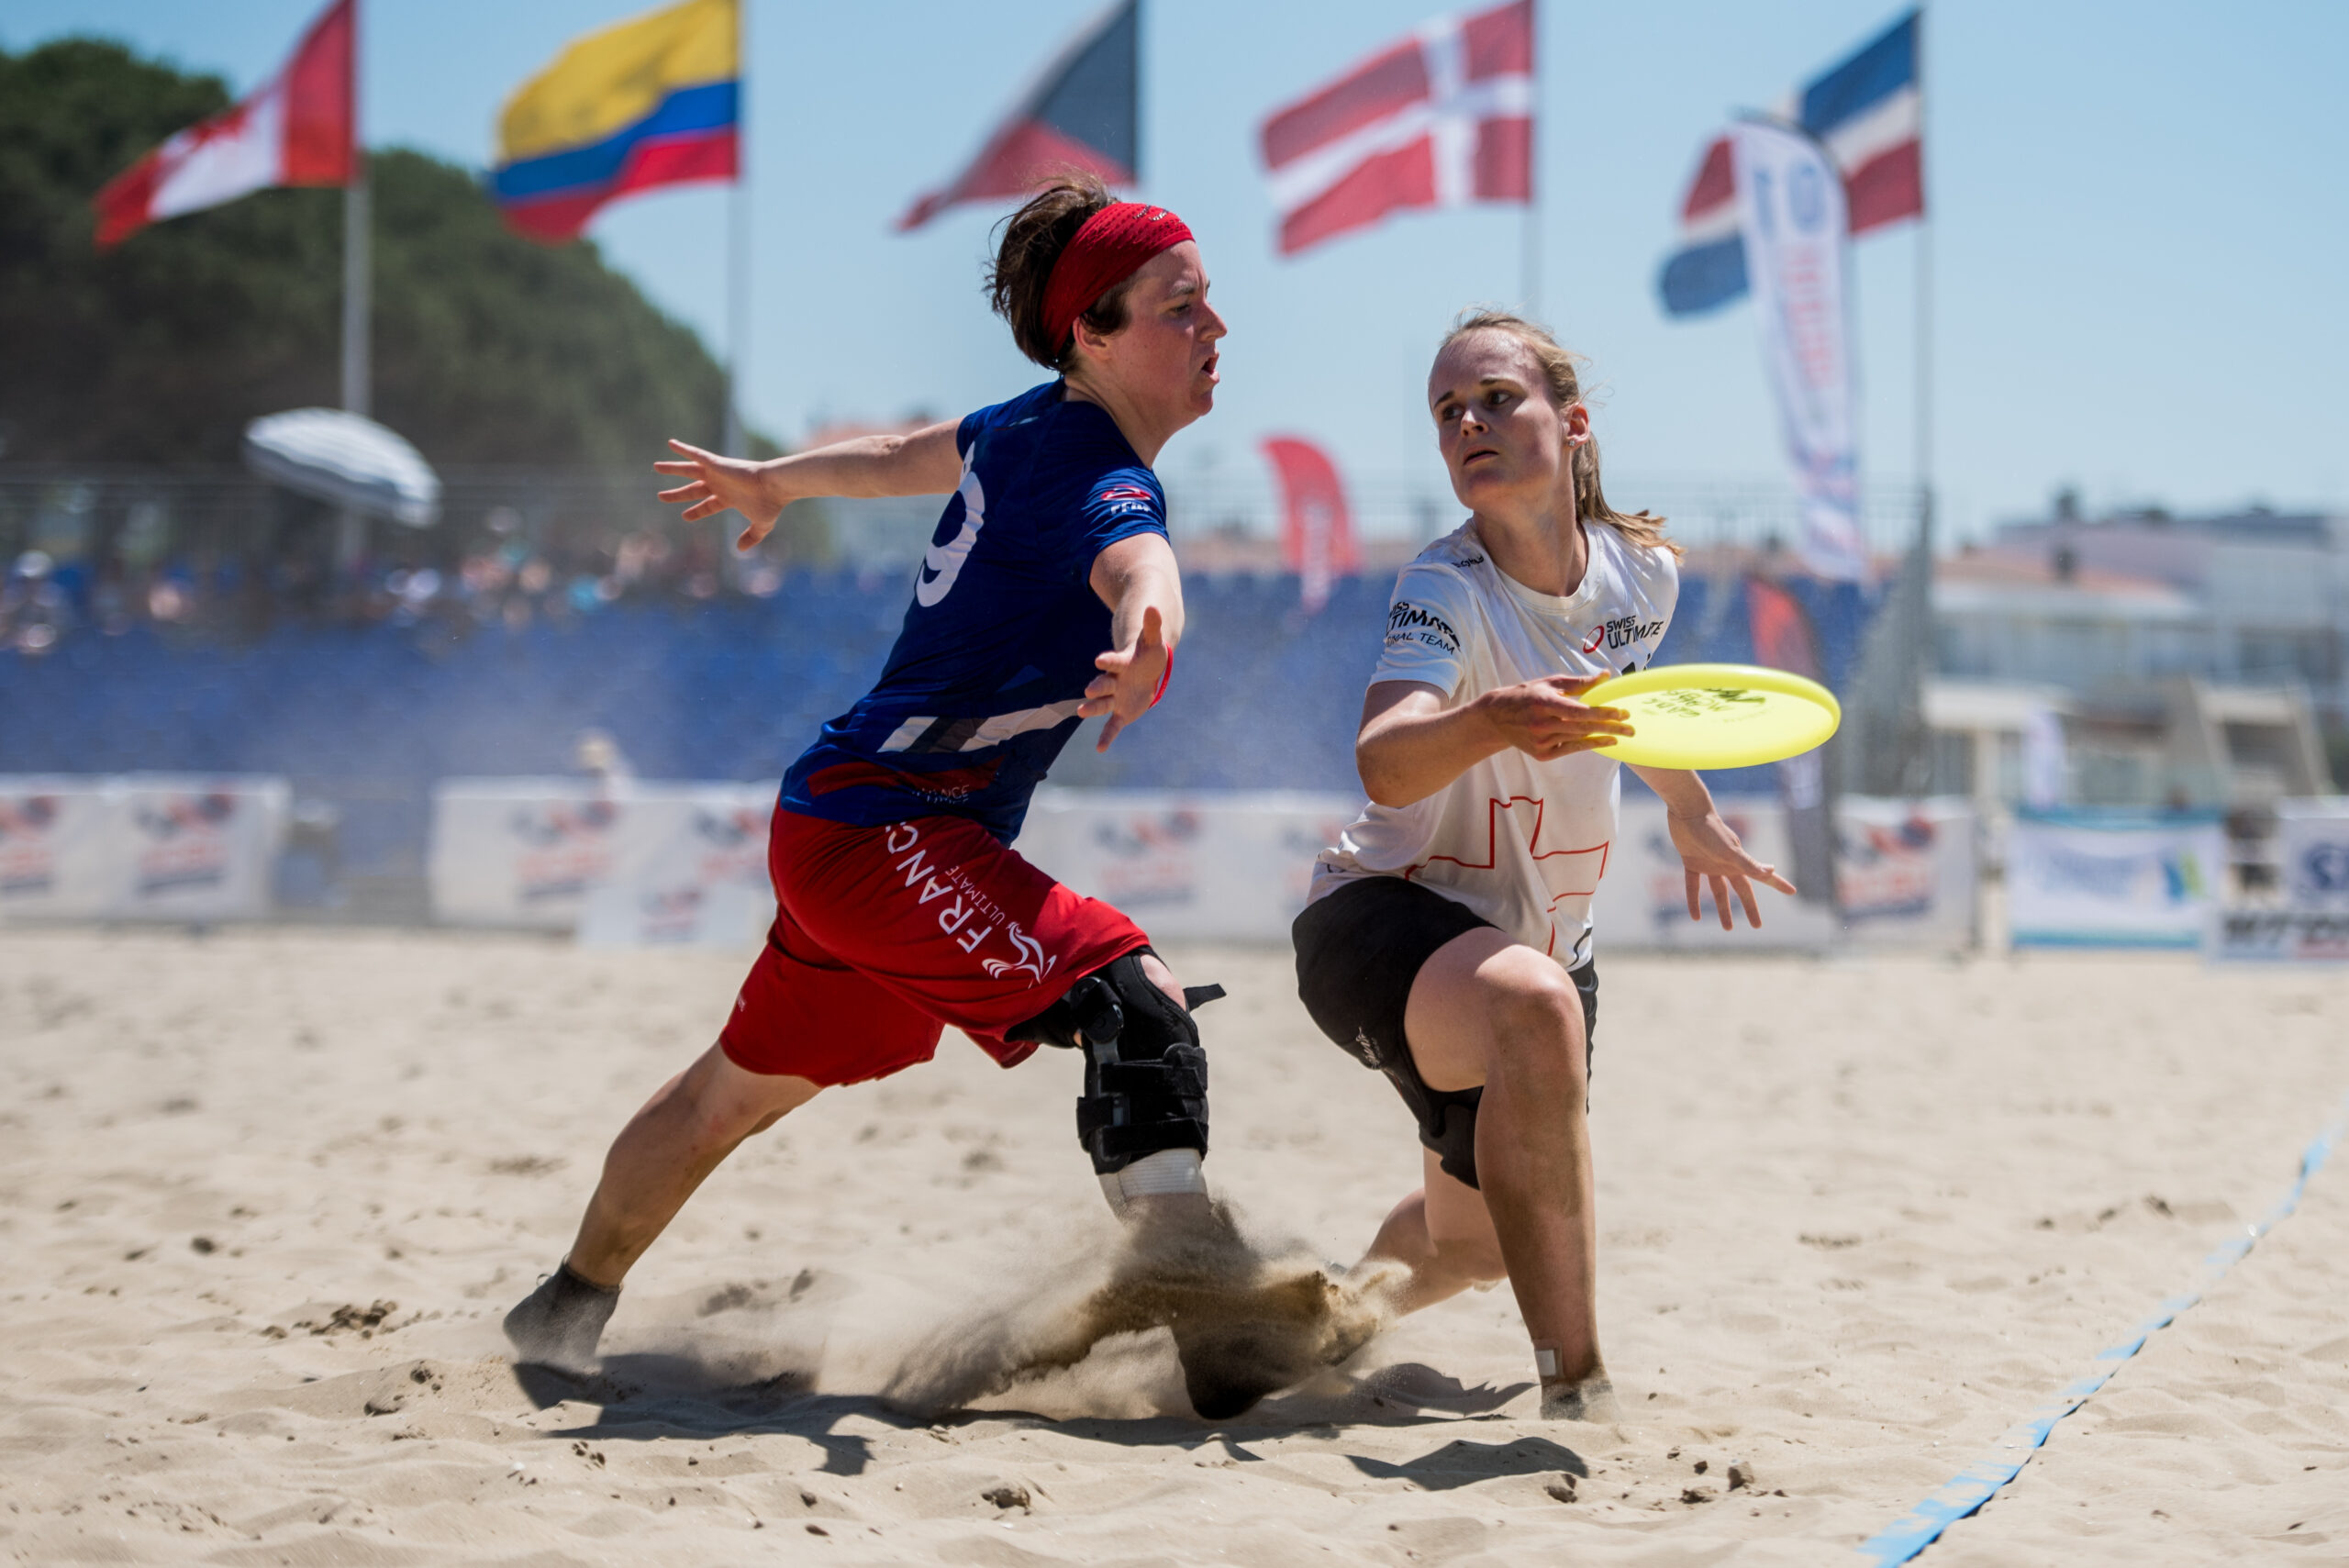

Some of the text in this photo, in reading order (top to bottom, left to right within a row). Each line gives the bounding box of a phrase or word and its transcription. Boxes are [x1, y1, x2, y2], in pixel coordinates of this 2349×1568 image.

[1606, 615, 1636, 633] SWISS
[1607, 620, 1664, 650] ULTIMATE
[1419, 632, 1455, 656] TEAM
[885, 820, 992, 954] FRANC
[945, 864, 1006, 927] ULTIMATE
